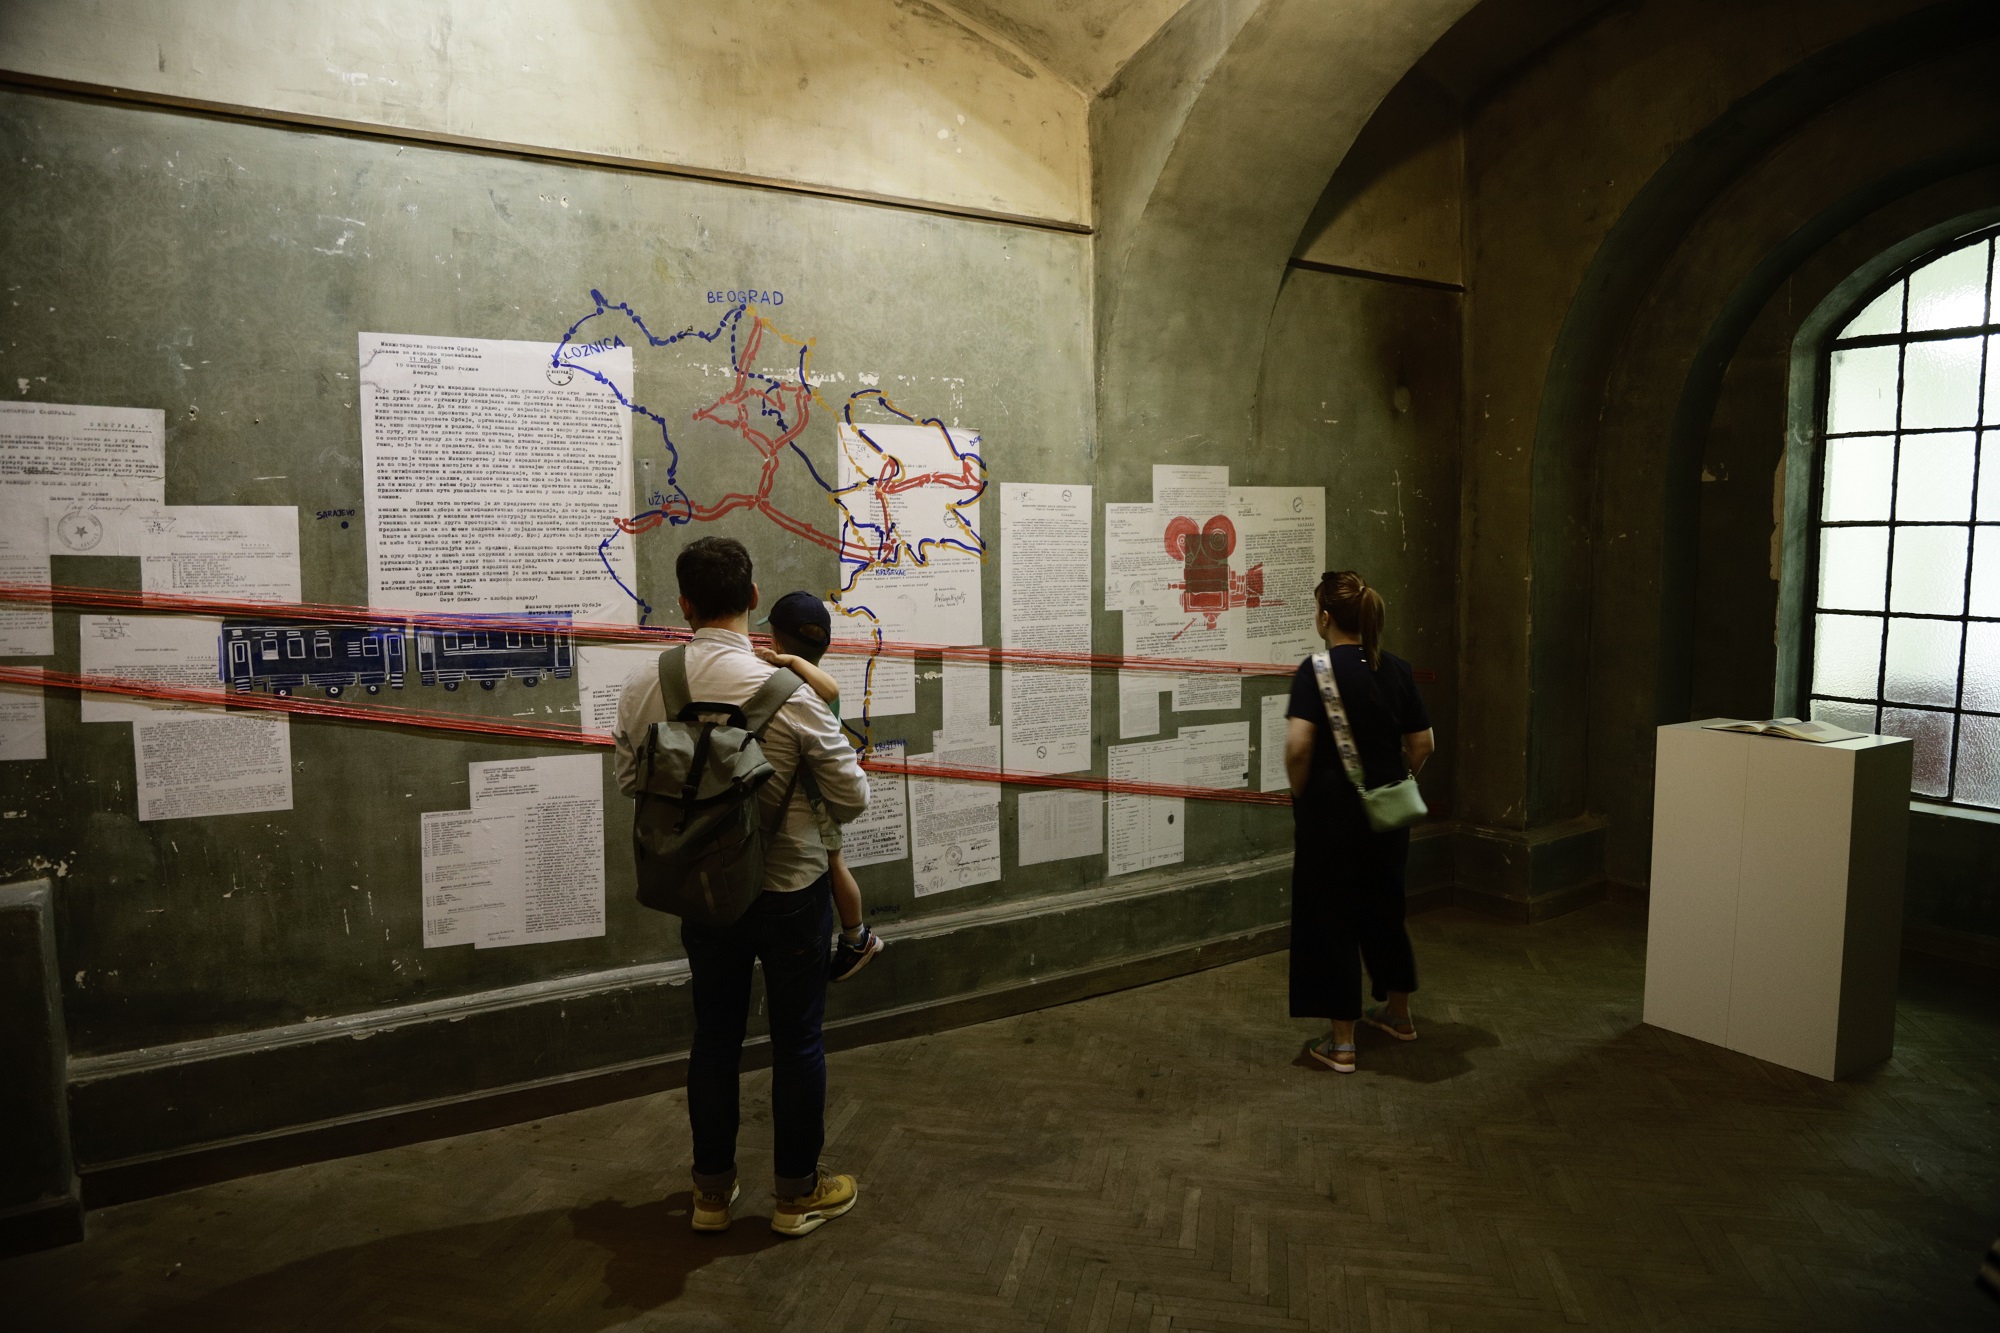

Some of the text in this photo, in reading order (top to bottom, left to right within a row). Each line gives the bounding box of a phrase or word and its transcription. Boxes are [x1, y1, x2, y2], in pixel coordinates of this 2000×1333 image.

[707, 289, 784, 306] BEOGRAD
[563, 335, 626, 359] LOZNICA
[648, 490, 680, 506] UŽICE
[316, 509, 356, 520] SARAJEVO
